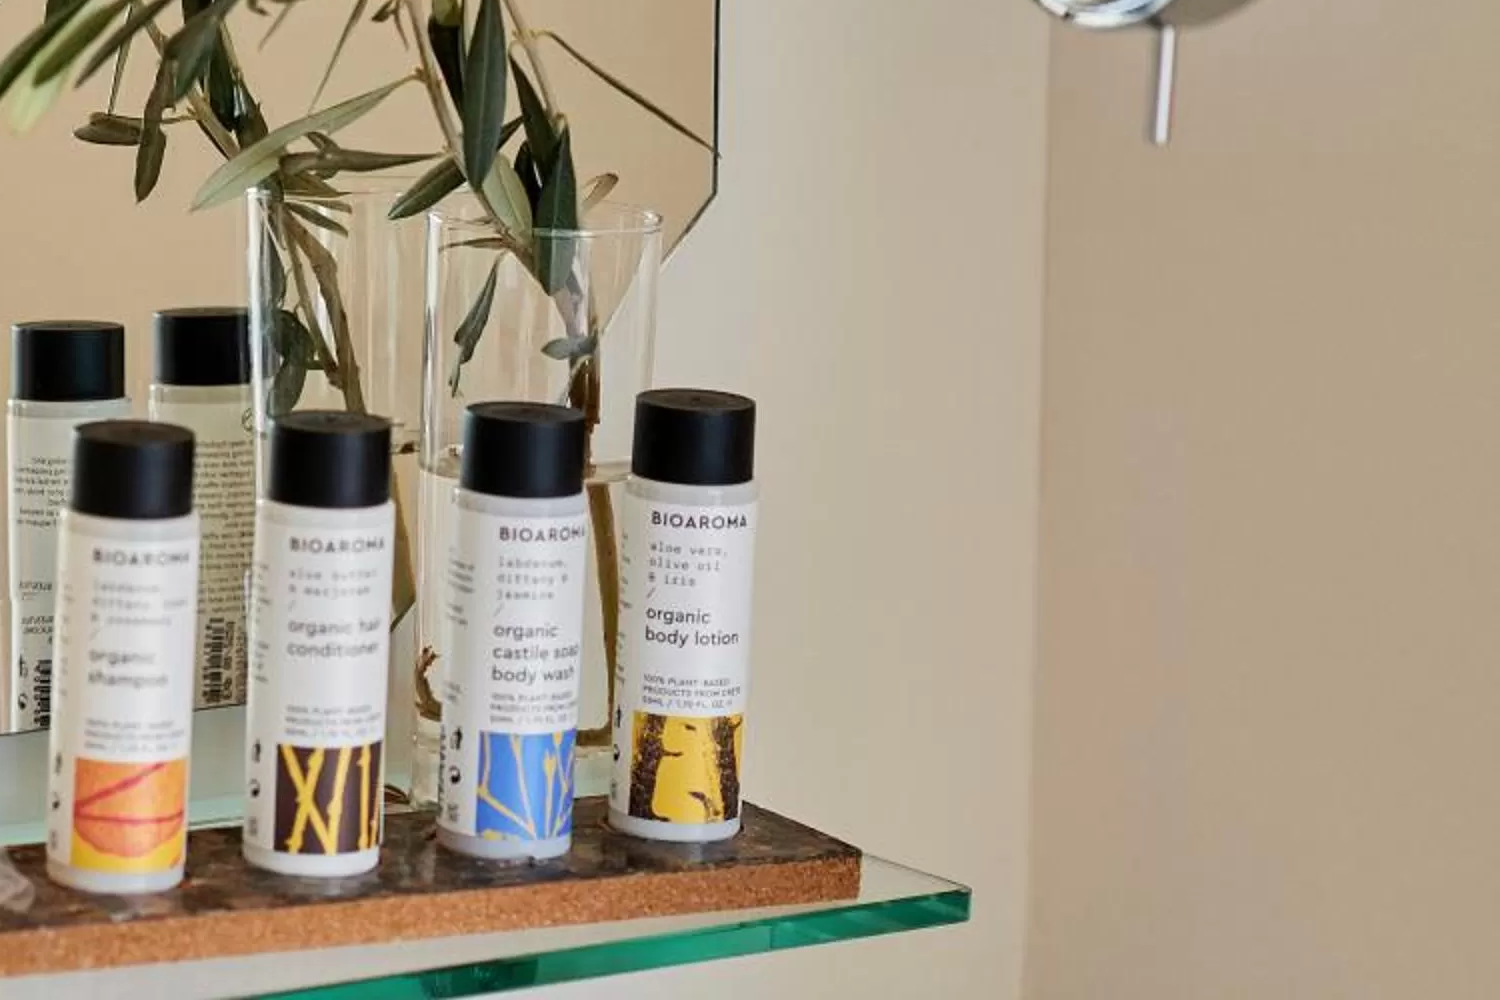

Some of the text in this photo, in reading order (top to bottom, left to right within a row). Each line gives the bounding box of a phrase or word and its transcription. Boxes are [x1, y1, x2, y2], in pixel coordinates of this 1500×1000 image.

[650, 510, 748, 530] BIOAROMA
[645, 607, 712, 625] organic
[288, 620, 353, 638] organic
[493, 624, 561, 641] organic
[644, 625, 740, 648] body lotion
[492, 664, 537, 686] body
